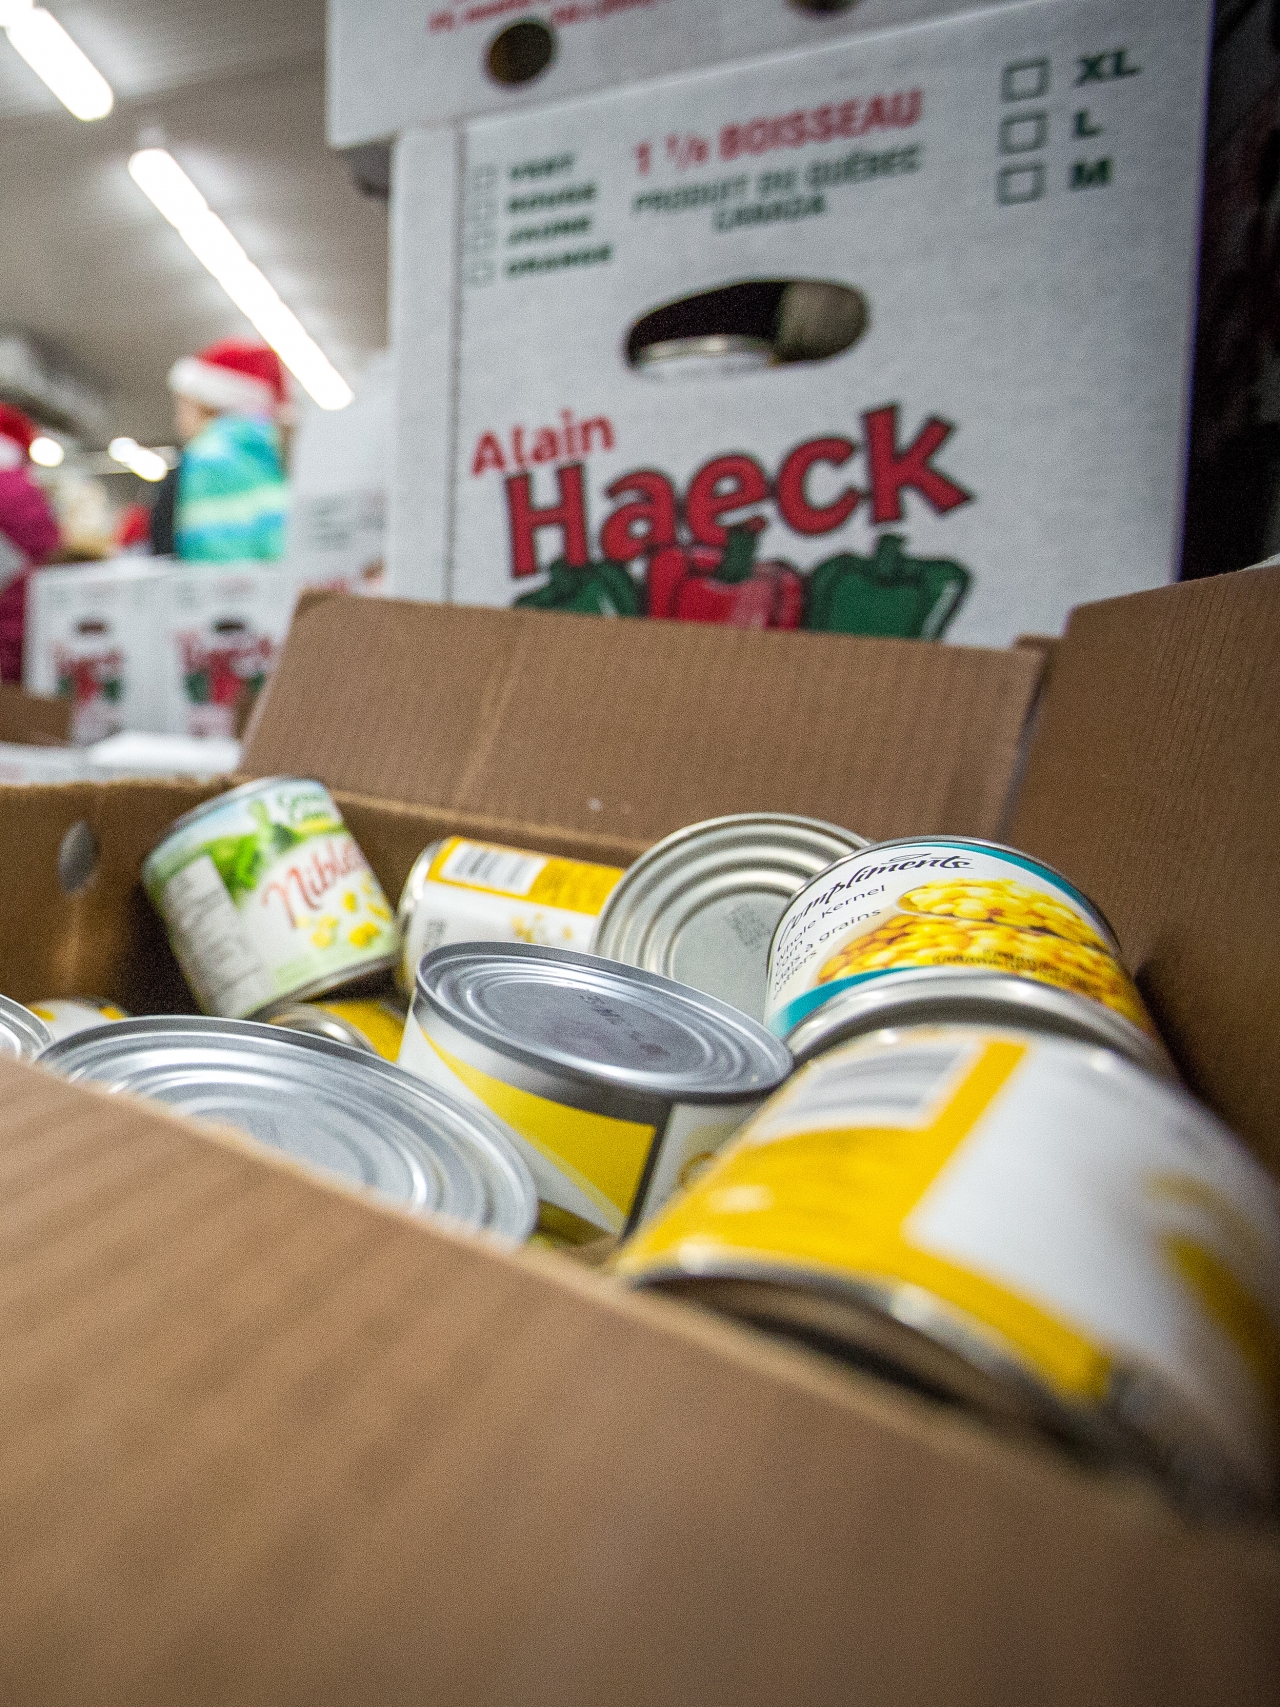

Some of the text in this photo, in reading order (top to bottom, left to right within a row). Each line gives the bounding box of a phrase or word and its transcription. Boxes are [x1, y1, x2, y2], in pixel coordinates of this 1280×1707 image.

[1074, 47, 1142, 88] XL
[719, 88, 923, 161] BOISSEAU
[1074, 108, 1105, 139] L
[631, 142, 924, 214] PRODUIT DU QUÉBEC
[1072, 155, 1113, 189] M
[713, 194, 826, 231] CANADA
[471, 409, 616, 477] Alain
[506, 405, 975, 578] Haeck
[776, 920, 816, 966] Whole
[821, 885, 885, 918] Kernel
[819, 909, 881, 943] grains
